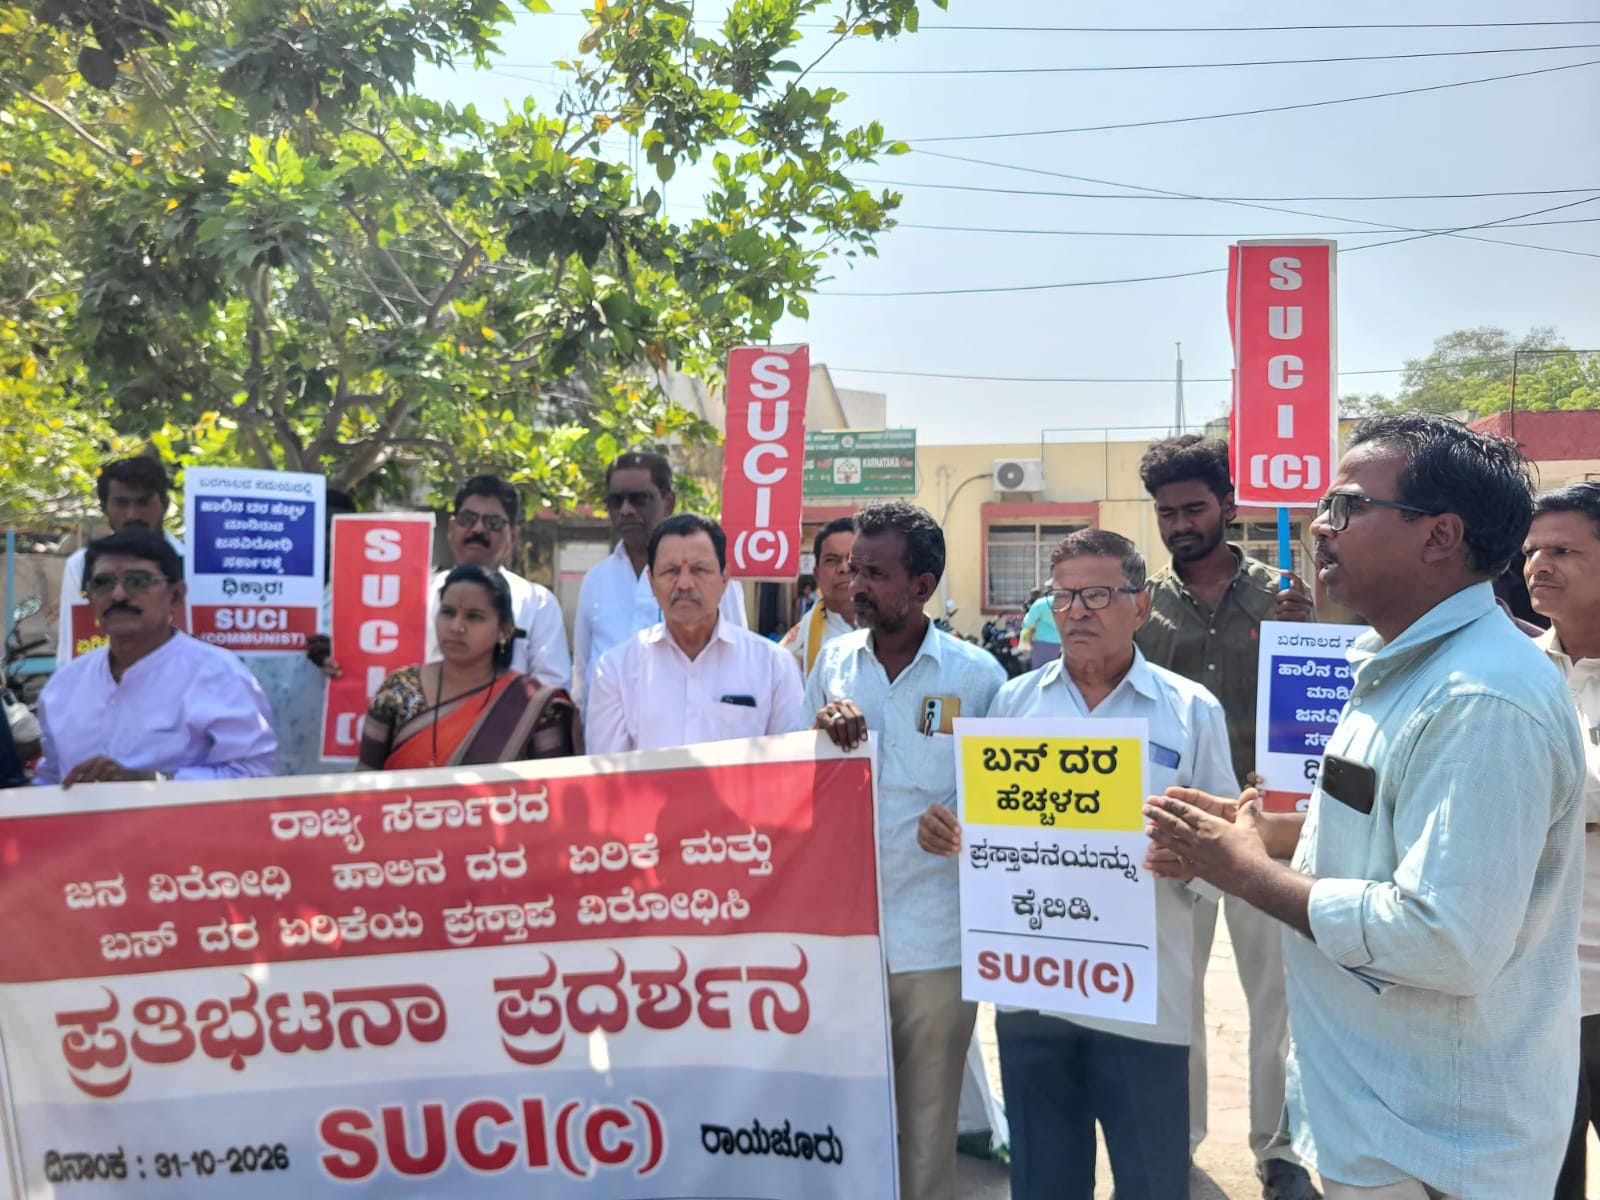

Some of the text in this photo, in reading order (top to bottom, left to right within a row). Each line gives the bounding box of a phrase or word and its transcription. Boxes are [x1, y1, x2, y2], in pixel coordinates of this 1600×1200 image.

[202, 631, 306, 647] (COMMUNIST)
[215, 608, 288, 630] SUCI
[1277, 633, 1341, 649] ಬರಗಾಲದ
[1278, 660, 1353, 679] ಹಾಲಿನ ದ
[983, 743, 1118, 775] ಬಸ್ ದರ
[270, 785, 549, 853] ರಾಜ್ಯ ಸರ್ಕಾರದ
[996, 784, 1100, 826] ಹೆಚ್ಚಳದ
[64, 873, 127, 909] ಜನ
[149, 864, 292, 903] ವಿರೋಧಿ
[332, 850, 446, 890] ಹಾಲಿನ
[466, 843, 528, 881] ದರ
[680, 825, 773, 875] ಮತ್ತು
[969, 838, 1139, 882] ಪ್ರಸ್ತಾವನೆಯನ್ನು
[100, 921, 178, 961] ಬಸ್
[198, 916, 260, 953] ದರ
[443, 894, 557, 945] ಪ್ರಸ್ತಾಪ
[577, 886, 750, 926] ವಿರೋಧಿಸಿ
[1012, 888, 1099, 930] ಕೈಬಿಡಿ.
[977, 949, 1135, 1003] SUCI(C)
[55, 973, 448, 1099] ಪ್ರತಿಭಟನಾ
[700, 1117, 844, 1166] ರಾಯಚೂರು
[44, 1145, 128, 1185] ದಿನಾಂಕ
[154, 1143, 290, 1179] 31-10-2026
